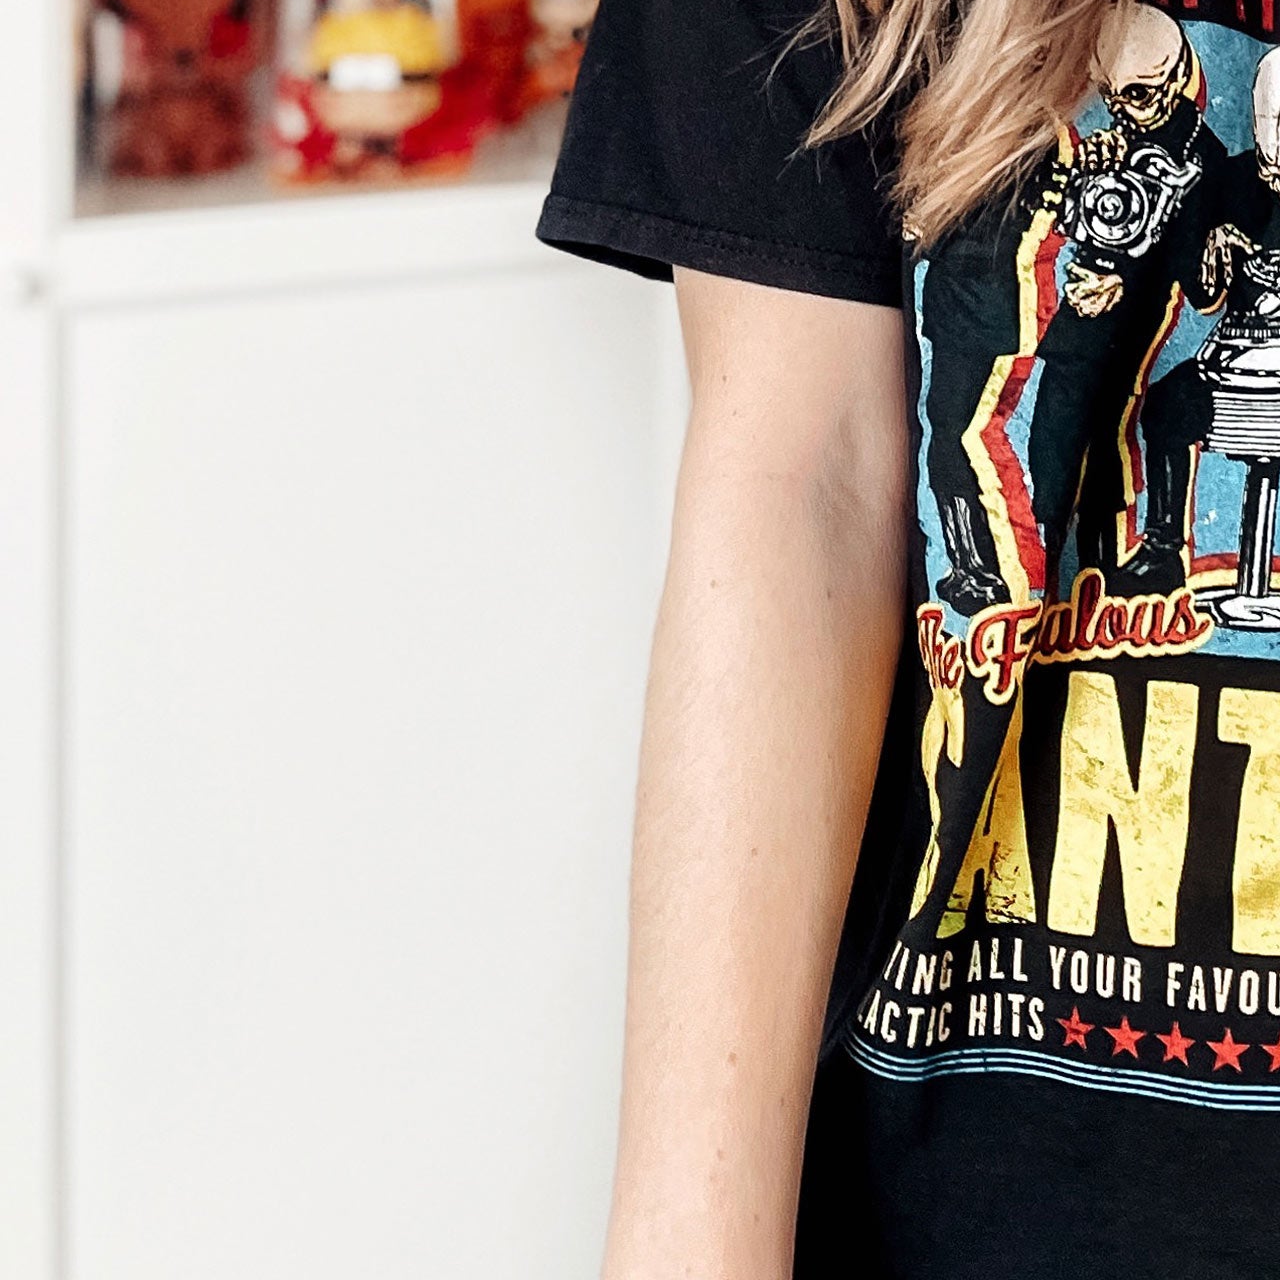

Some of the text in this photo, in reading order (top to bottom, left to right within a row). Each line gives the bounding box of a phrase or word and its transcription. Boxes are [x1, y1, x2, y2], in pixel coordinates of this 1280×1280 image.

[967, 937, 1028, 982] ALL
[1049, 945, 1142, 1003] YOUR
[858, 989, 1045, 1049] ACTIC HITS
